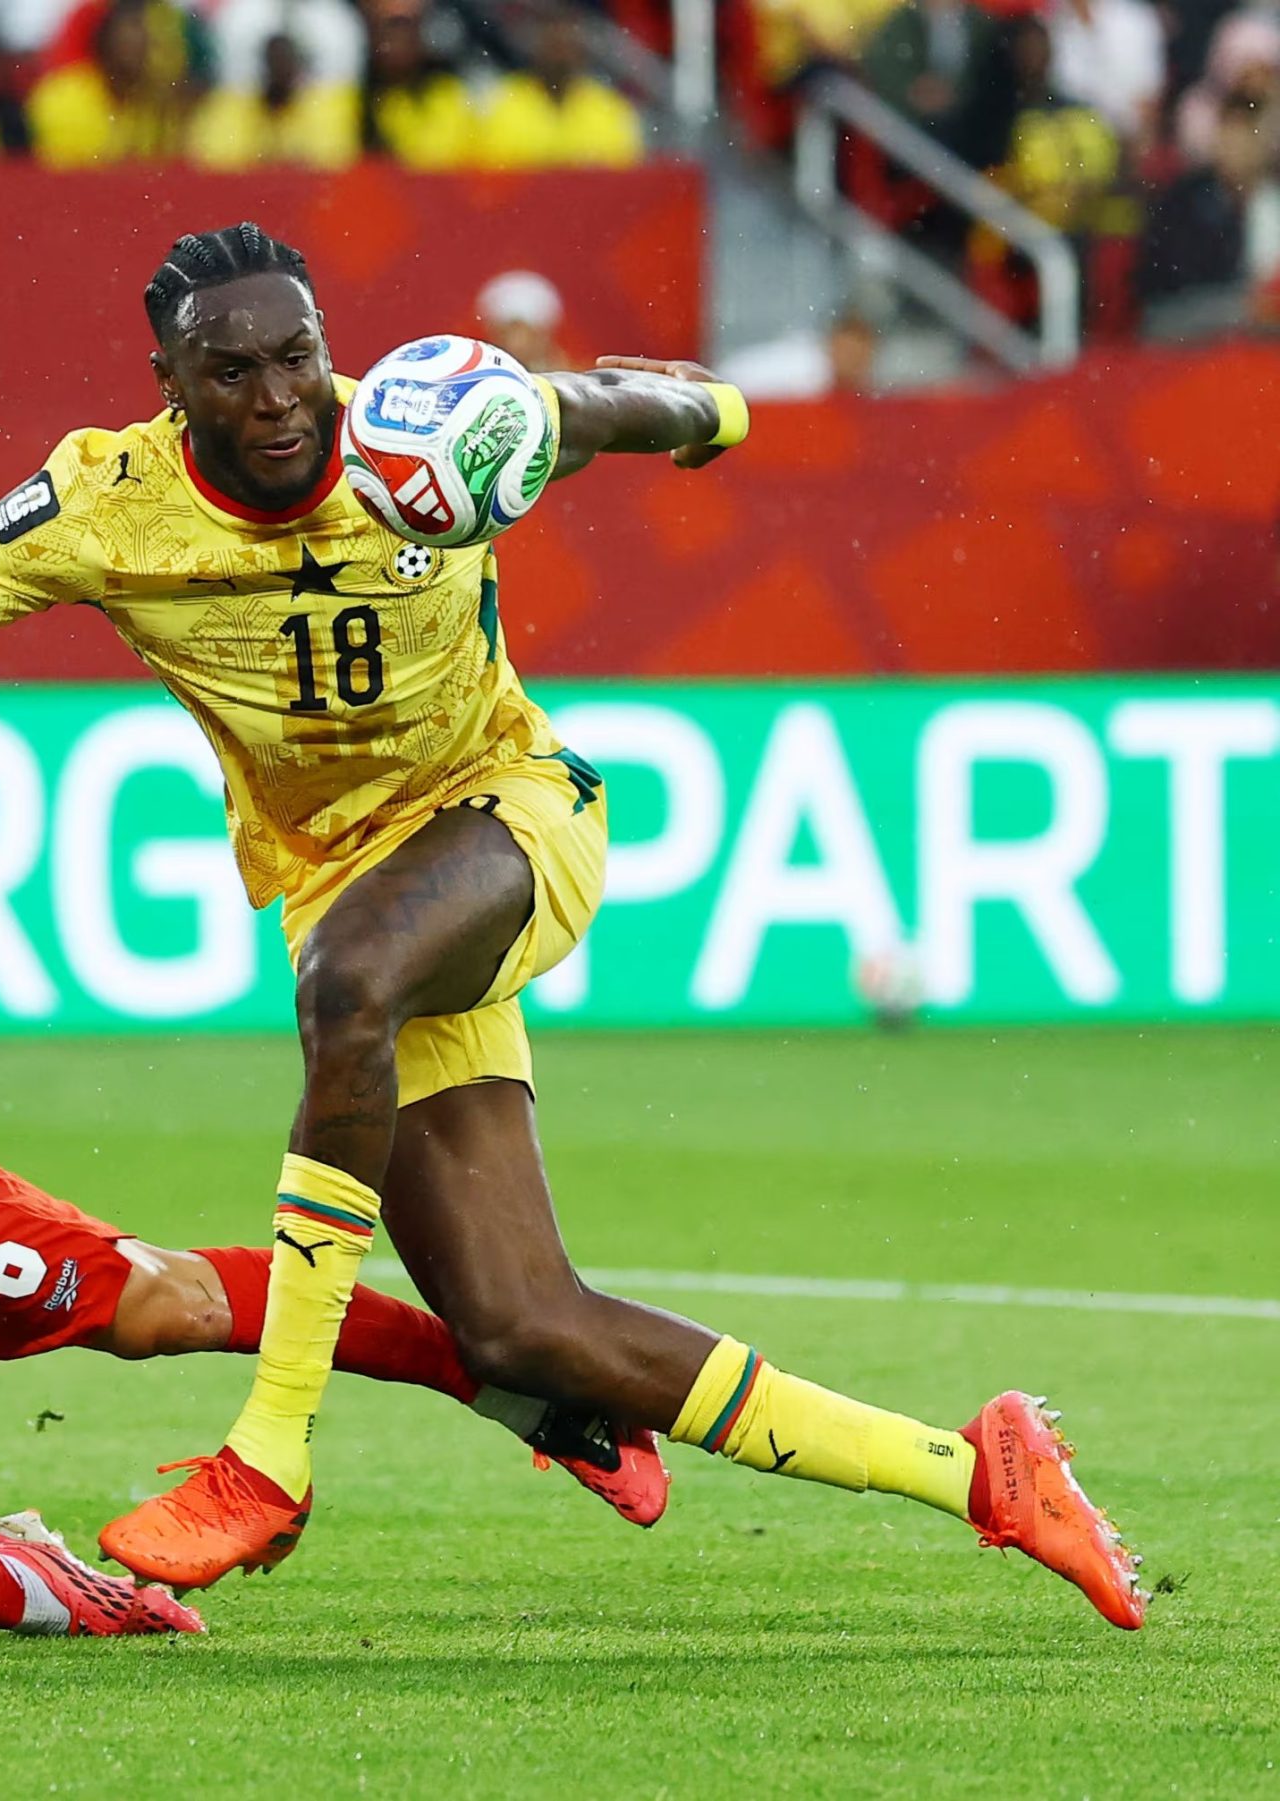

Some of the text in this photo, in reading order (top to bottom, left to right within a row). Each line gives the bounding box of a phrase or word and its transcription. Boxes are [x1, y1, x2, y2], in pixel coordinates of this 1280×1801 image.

[279, 604, 385, 711] 18
[529, 698, 1279, 1012] PART
[44, 1256, 75, 1310] Reebok
[999, 1429, 1018, 1501] NEMESIS
